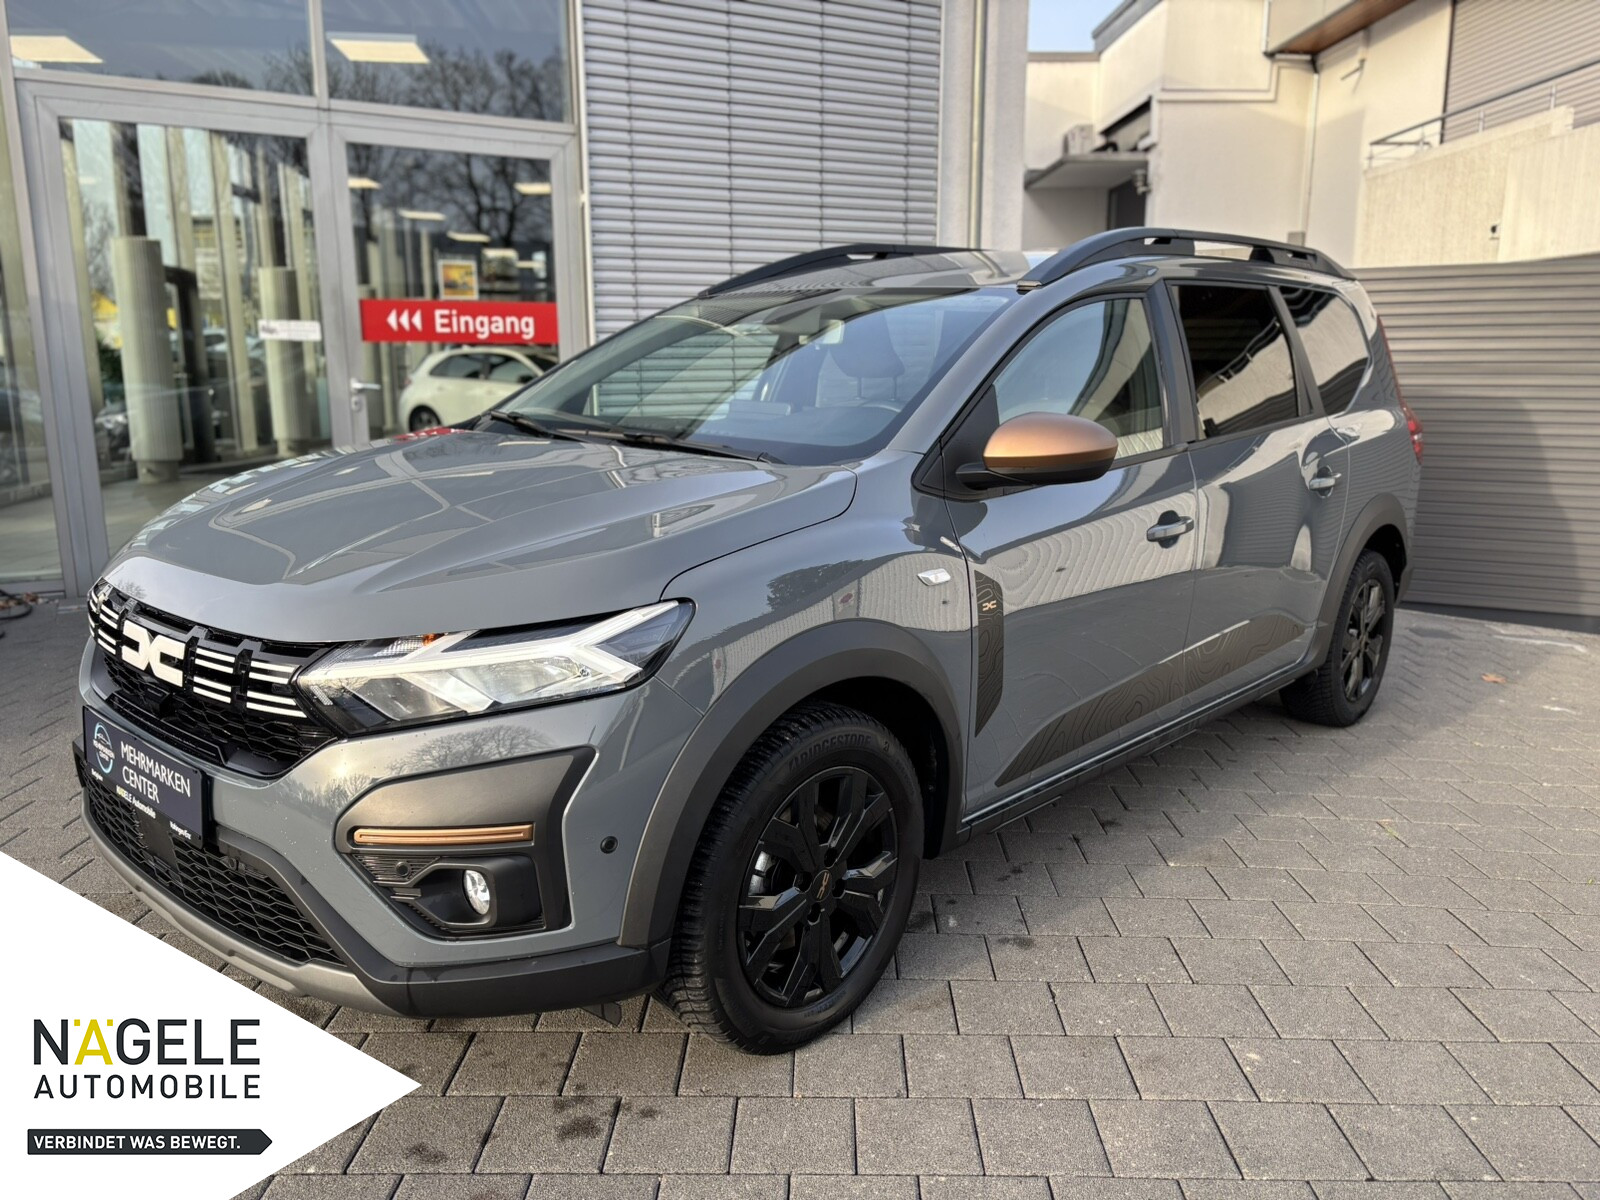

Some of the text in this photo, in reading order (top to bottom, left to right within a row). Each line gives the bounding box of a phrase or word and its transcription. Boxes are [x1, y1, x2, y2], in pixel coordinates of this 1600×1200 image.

[433, 309, 535, 340] Eingang
[120, 740, 191, 798] MEHRMARKEN
[122, 766, 160, 803] CENTER
